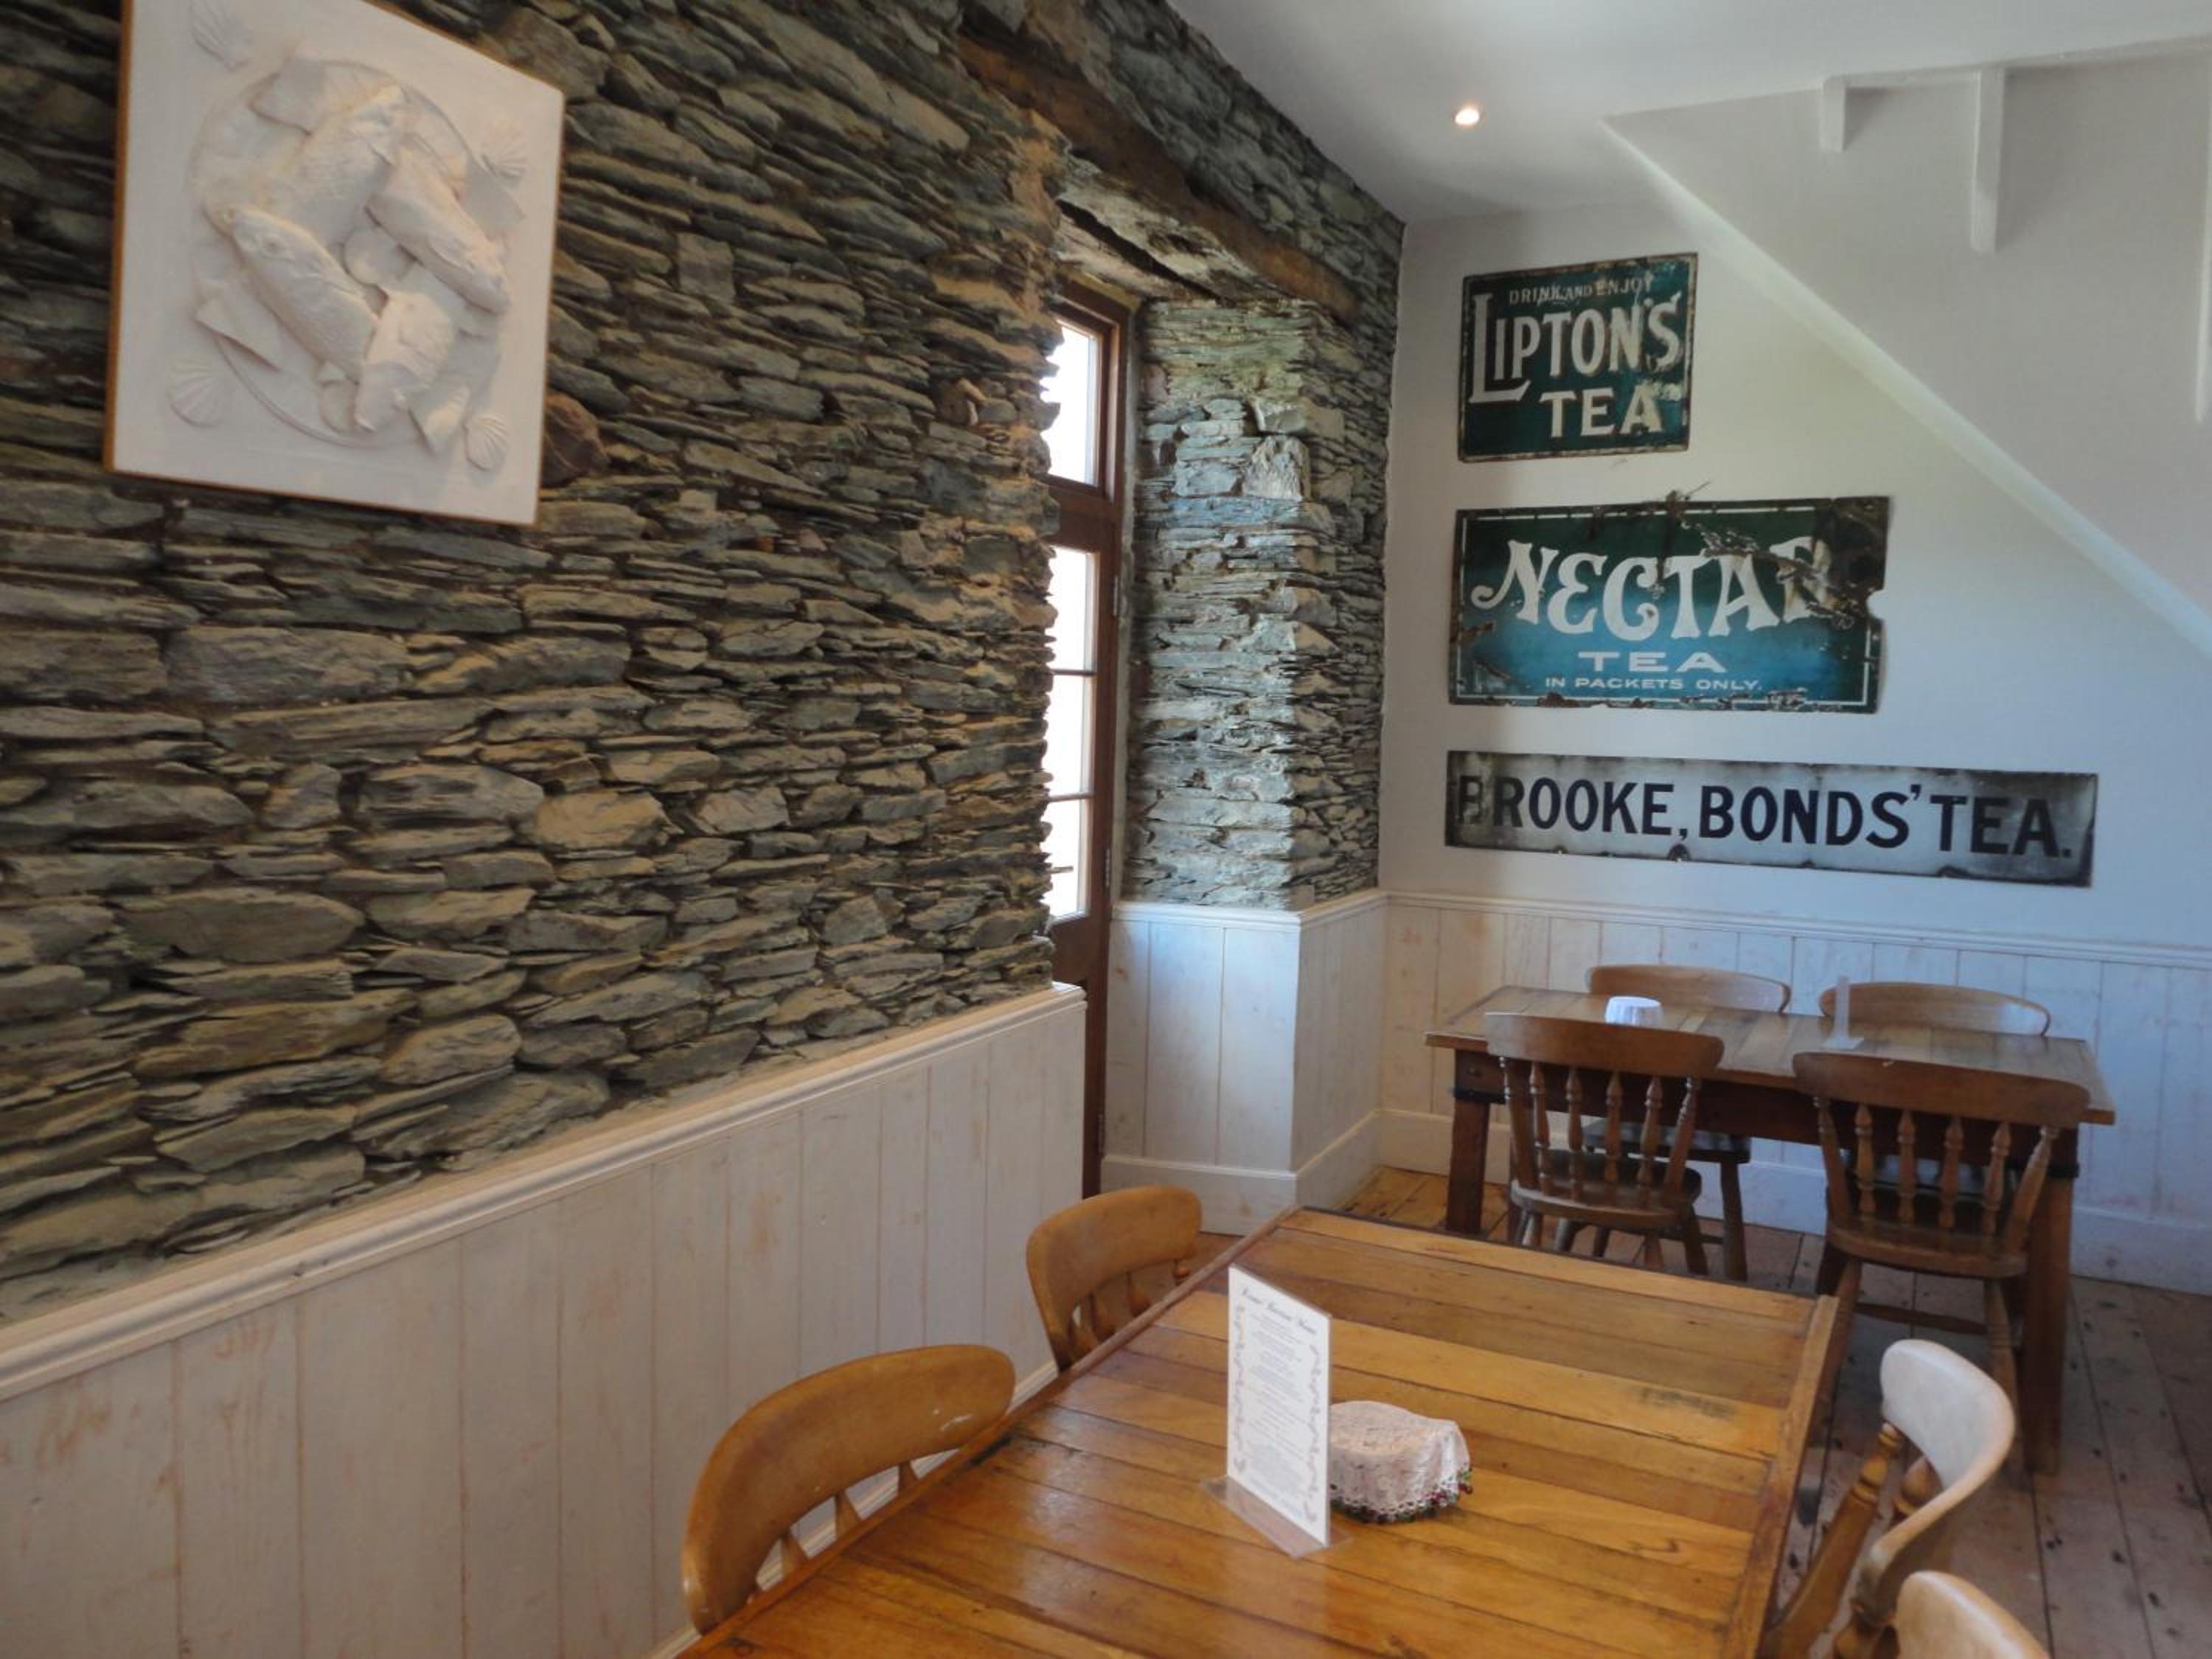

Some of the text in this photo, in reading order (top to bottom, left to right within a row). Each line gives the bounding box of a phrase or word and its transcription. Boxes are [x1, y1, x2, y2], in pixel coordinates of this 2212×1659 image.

[1509, 271, 1654, 305] DRINK AND ENJOY
[1468, 291, 1683, 403] LIPTON'S
[1539, 381, 1663, 438] TEA
[1545, 677, 1566, 689] IN
[1574, 677, 1684, 690] PACKETS
[1578, 650, 1728, 674] TEA
[1456, 774, 2073, 858] BROOKE, BONDS' TEA.
